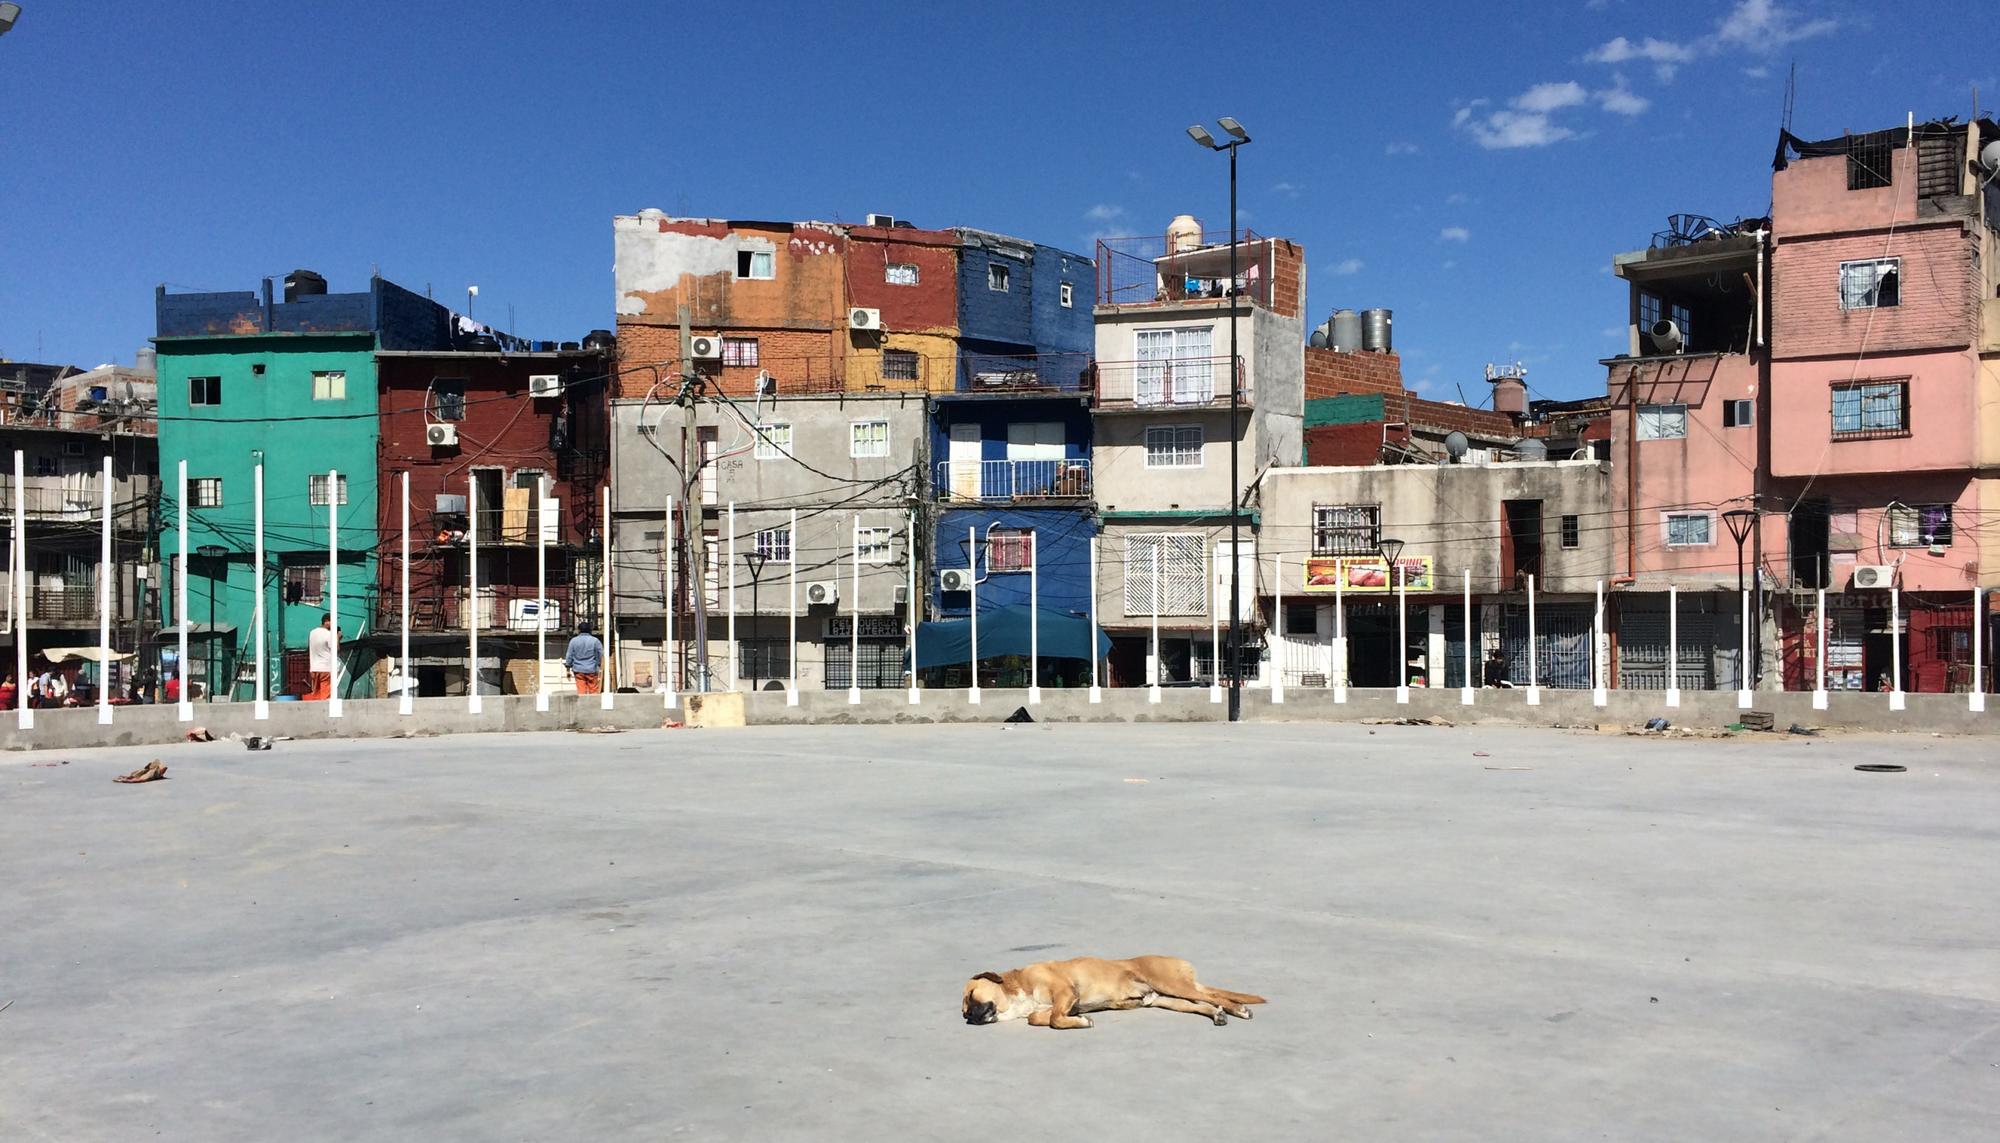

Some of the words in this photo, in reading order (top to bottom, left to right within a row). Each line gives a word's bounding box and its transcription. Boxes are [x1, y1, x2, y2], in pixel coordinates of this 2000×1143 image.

[720, 560, 740, 569] CAA
[832, 619, 897, 627] PELQUERIA
[832, 627, 898, 636] BIJUTERIA
